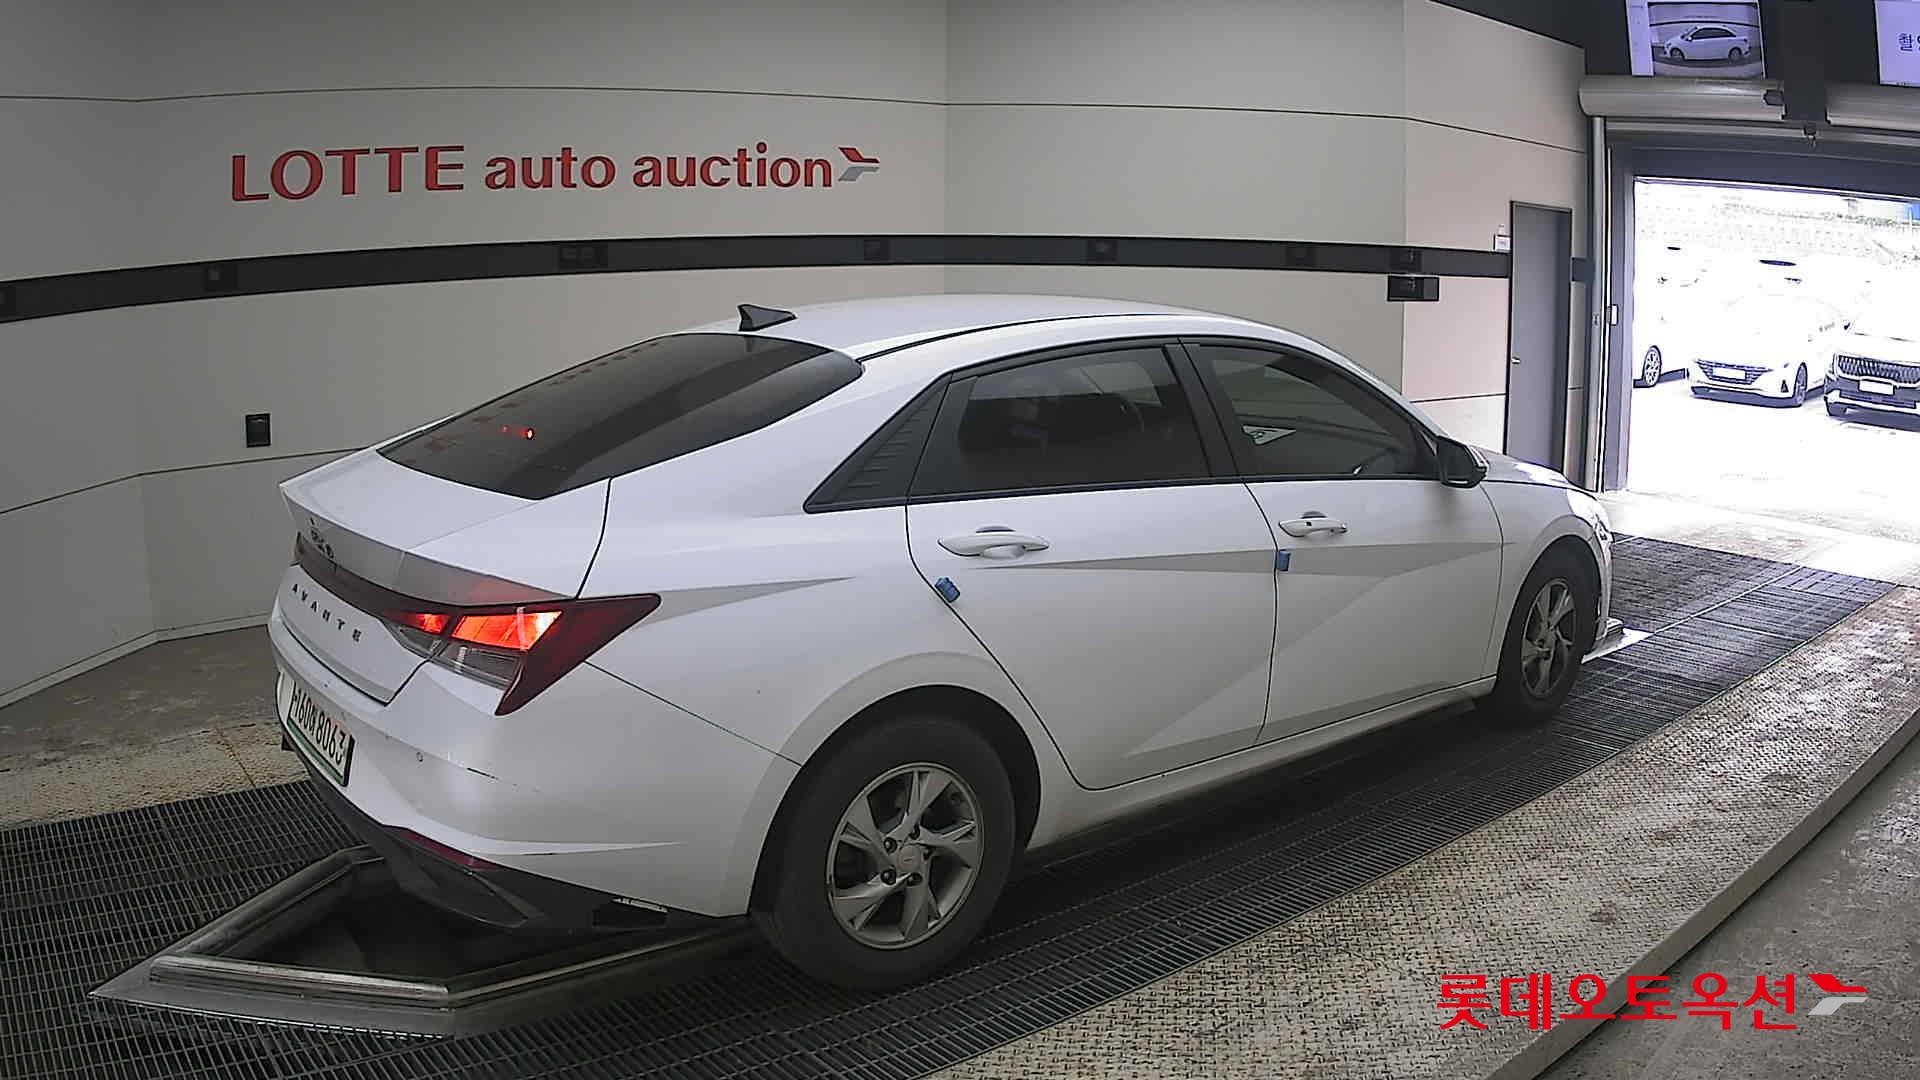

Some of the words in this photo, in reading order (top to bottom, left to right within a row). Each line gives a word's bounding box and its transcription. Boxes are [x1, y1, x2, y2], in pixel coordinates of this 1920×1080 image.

[232, 146, 465, 202] LOTTE
[485, 148, 616, 189] auto
[633, 142, 832, 189] auction
[291, 583, 363, 643] AVANTE
